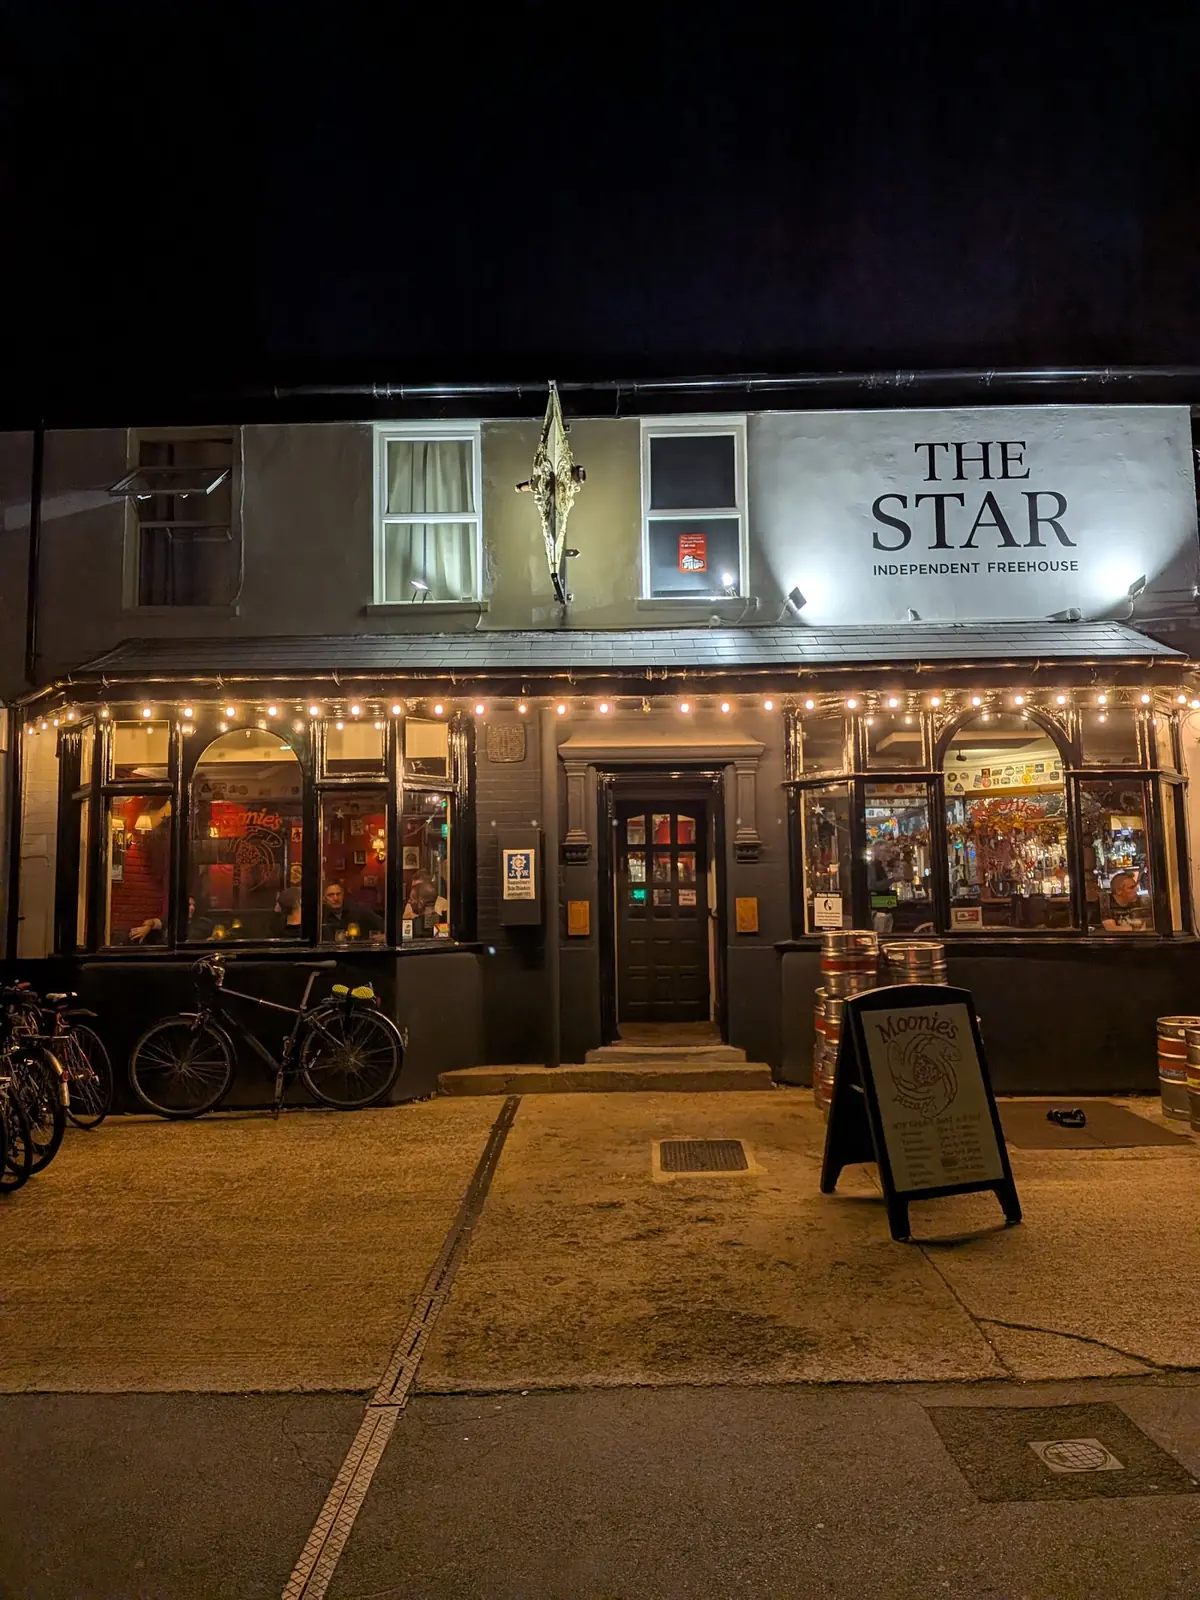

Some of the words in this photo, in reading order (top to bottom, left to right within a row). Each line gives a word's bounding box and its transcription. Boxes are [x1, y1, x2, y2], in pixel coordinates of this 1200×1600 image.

[914, 440, 1031, 481] THE
[871, 490, 1077, 551] STAR
[873, 562, 980, 576] INDEPENDENT
[987, 560, 1079, 573] FREEHOUSE
